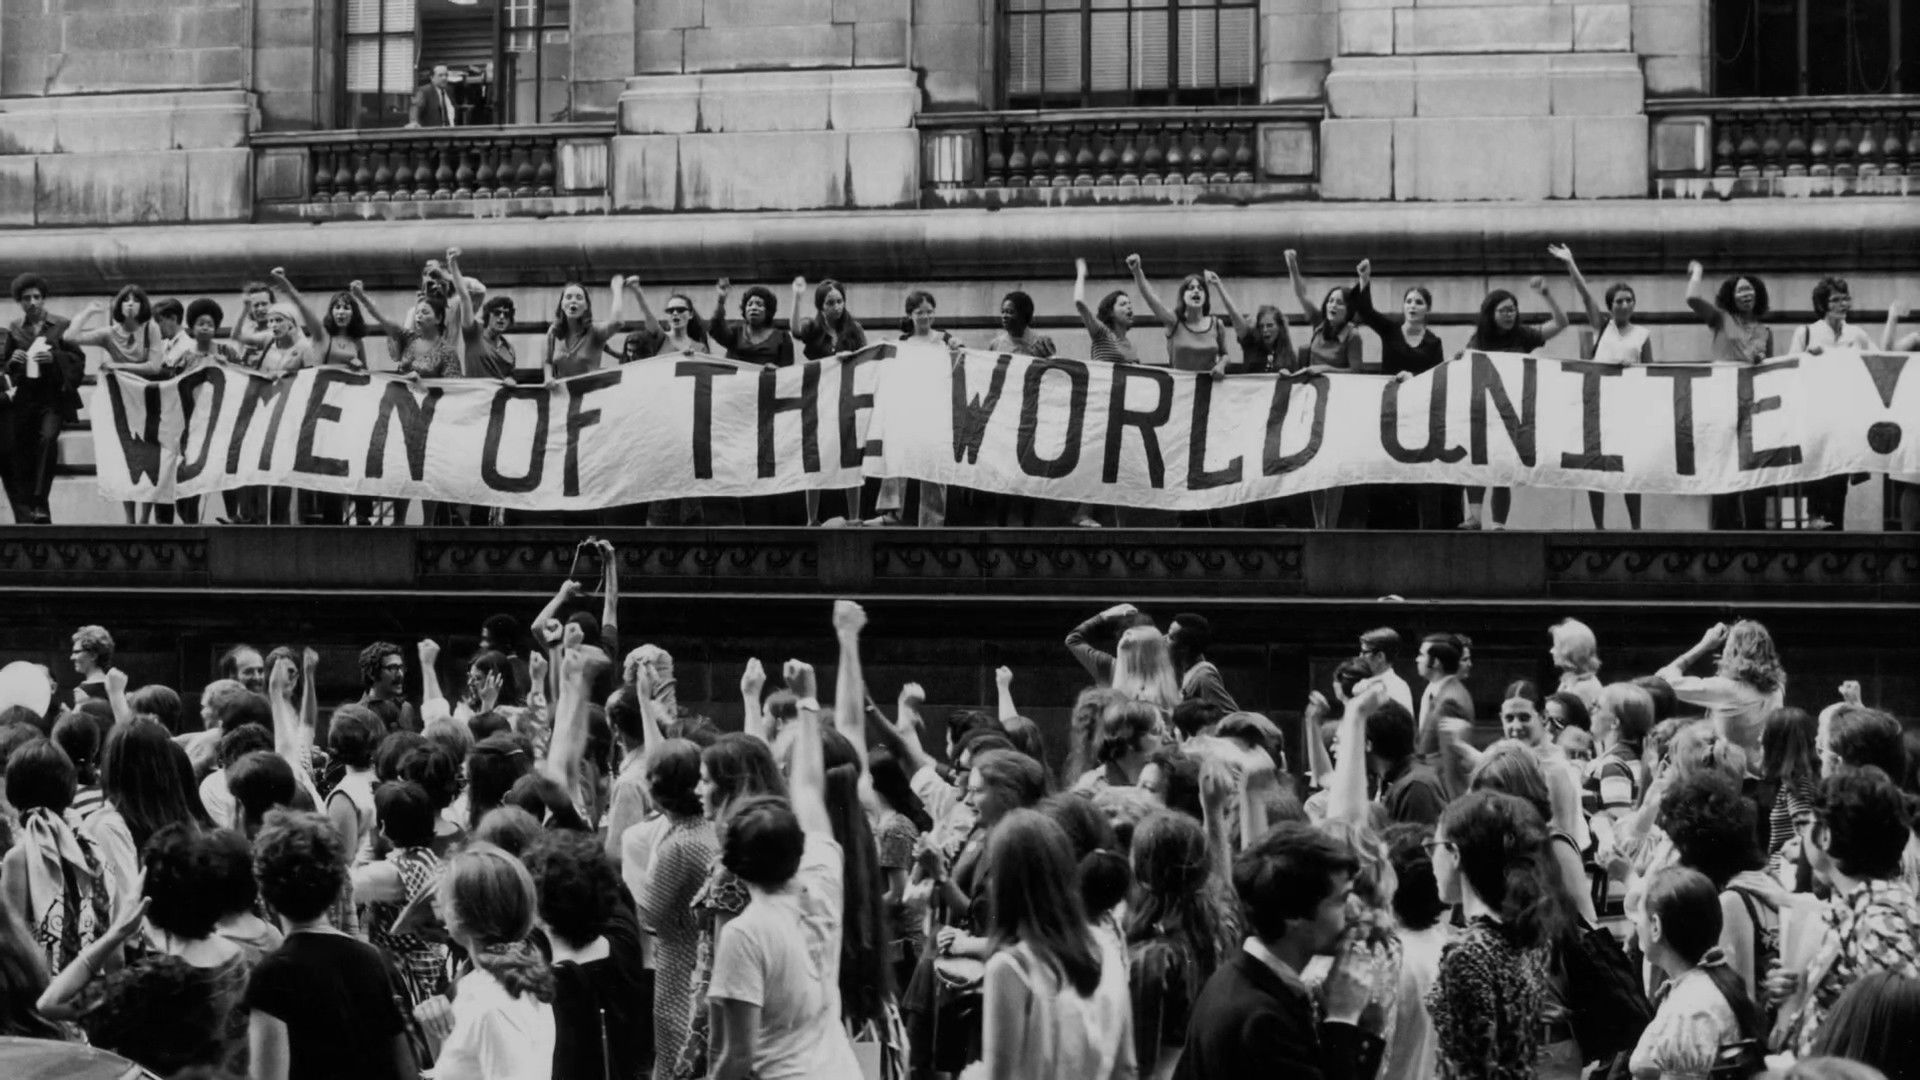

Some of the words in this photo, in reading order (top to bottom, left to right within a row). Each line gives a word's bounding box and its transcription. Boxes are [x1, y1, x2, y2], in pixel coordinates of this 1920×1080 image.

[106, 366, 444, 486] WOMEN
[481, 370, 622, 497] OF
[674, 345, 897, 479] THE
[950, 353, 1330, 490] WORLD
